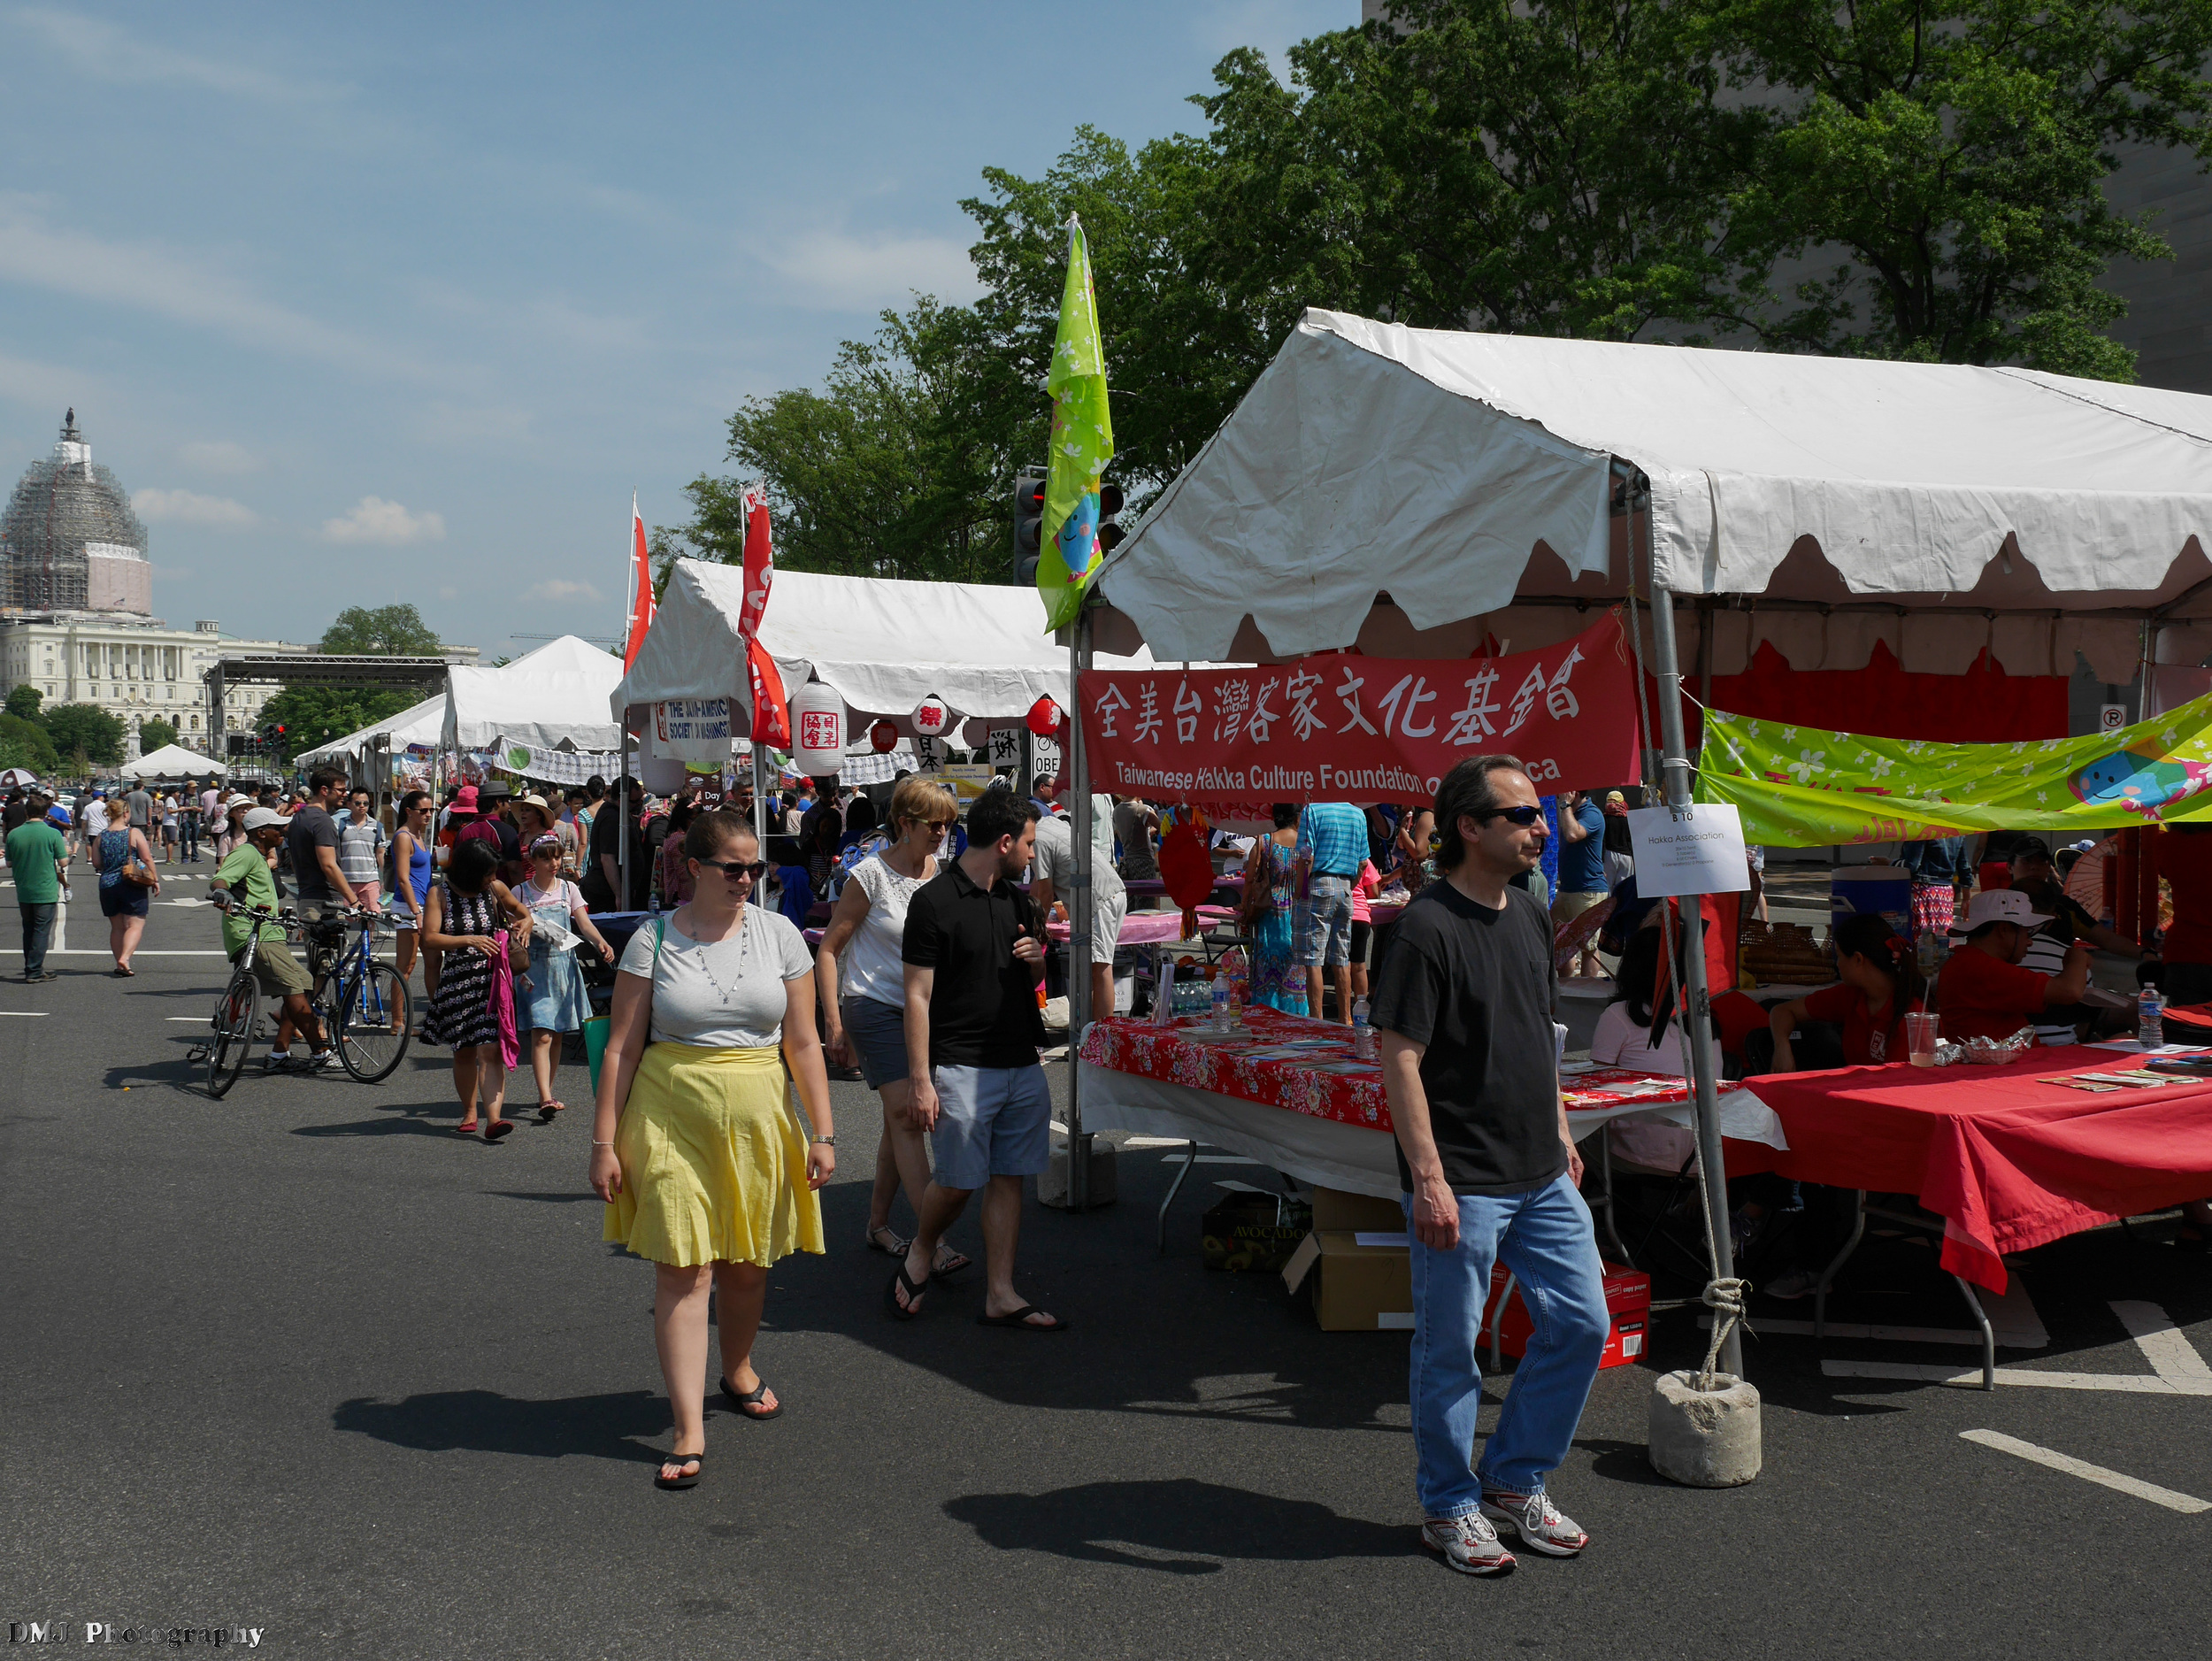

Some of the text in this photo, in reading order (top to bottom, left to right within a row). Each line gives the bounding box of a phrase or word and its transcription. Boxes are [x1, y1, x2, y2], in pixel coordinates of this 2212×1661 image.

[668, 701, 684, 718] THE
[919, 705, 942, 727] 祭
[918, 736, 941, 772] 日本
[1036, 757, 1061, 773] OBE
[1116, 761, 1442, 796] Taiwanese Hakka Culture Foundation o
[704, 791, 720, 801] Day
[1681, 812, 1693, 821] 10
[1648, 832, 1724, 844] Hakka Association
